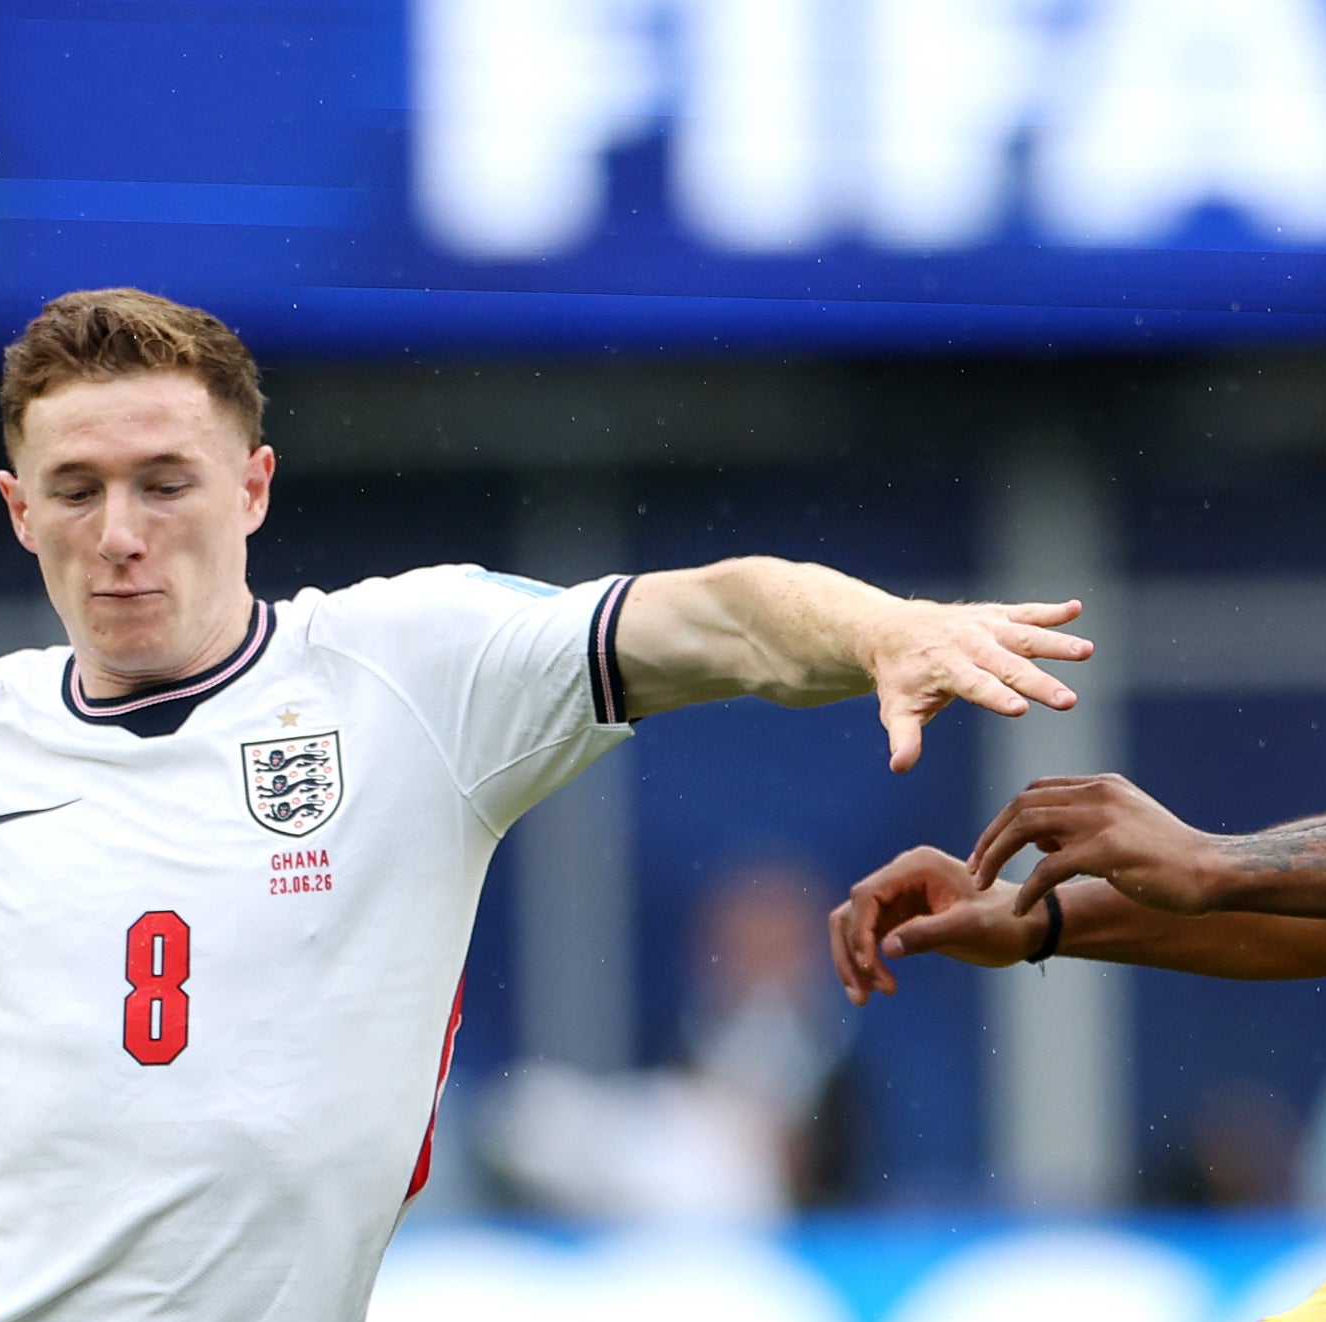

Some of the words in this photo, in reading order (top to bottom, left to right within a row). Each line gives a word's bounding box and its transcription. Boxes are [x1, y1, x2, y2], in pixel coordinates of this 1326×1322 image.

[271, 849, 330, 871] GHANA
[269, 873, 333, 895] 23.06.26
[122, 910, 191, 1066] 8
